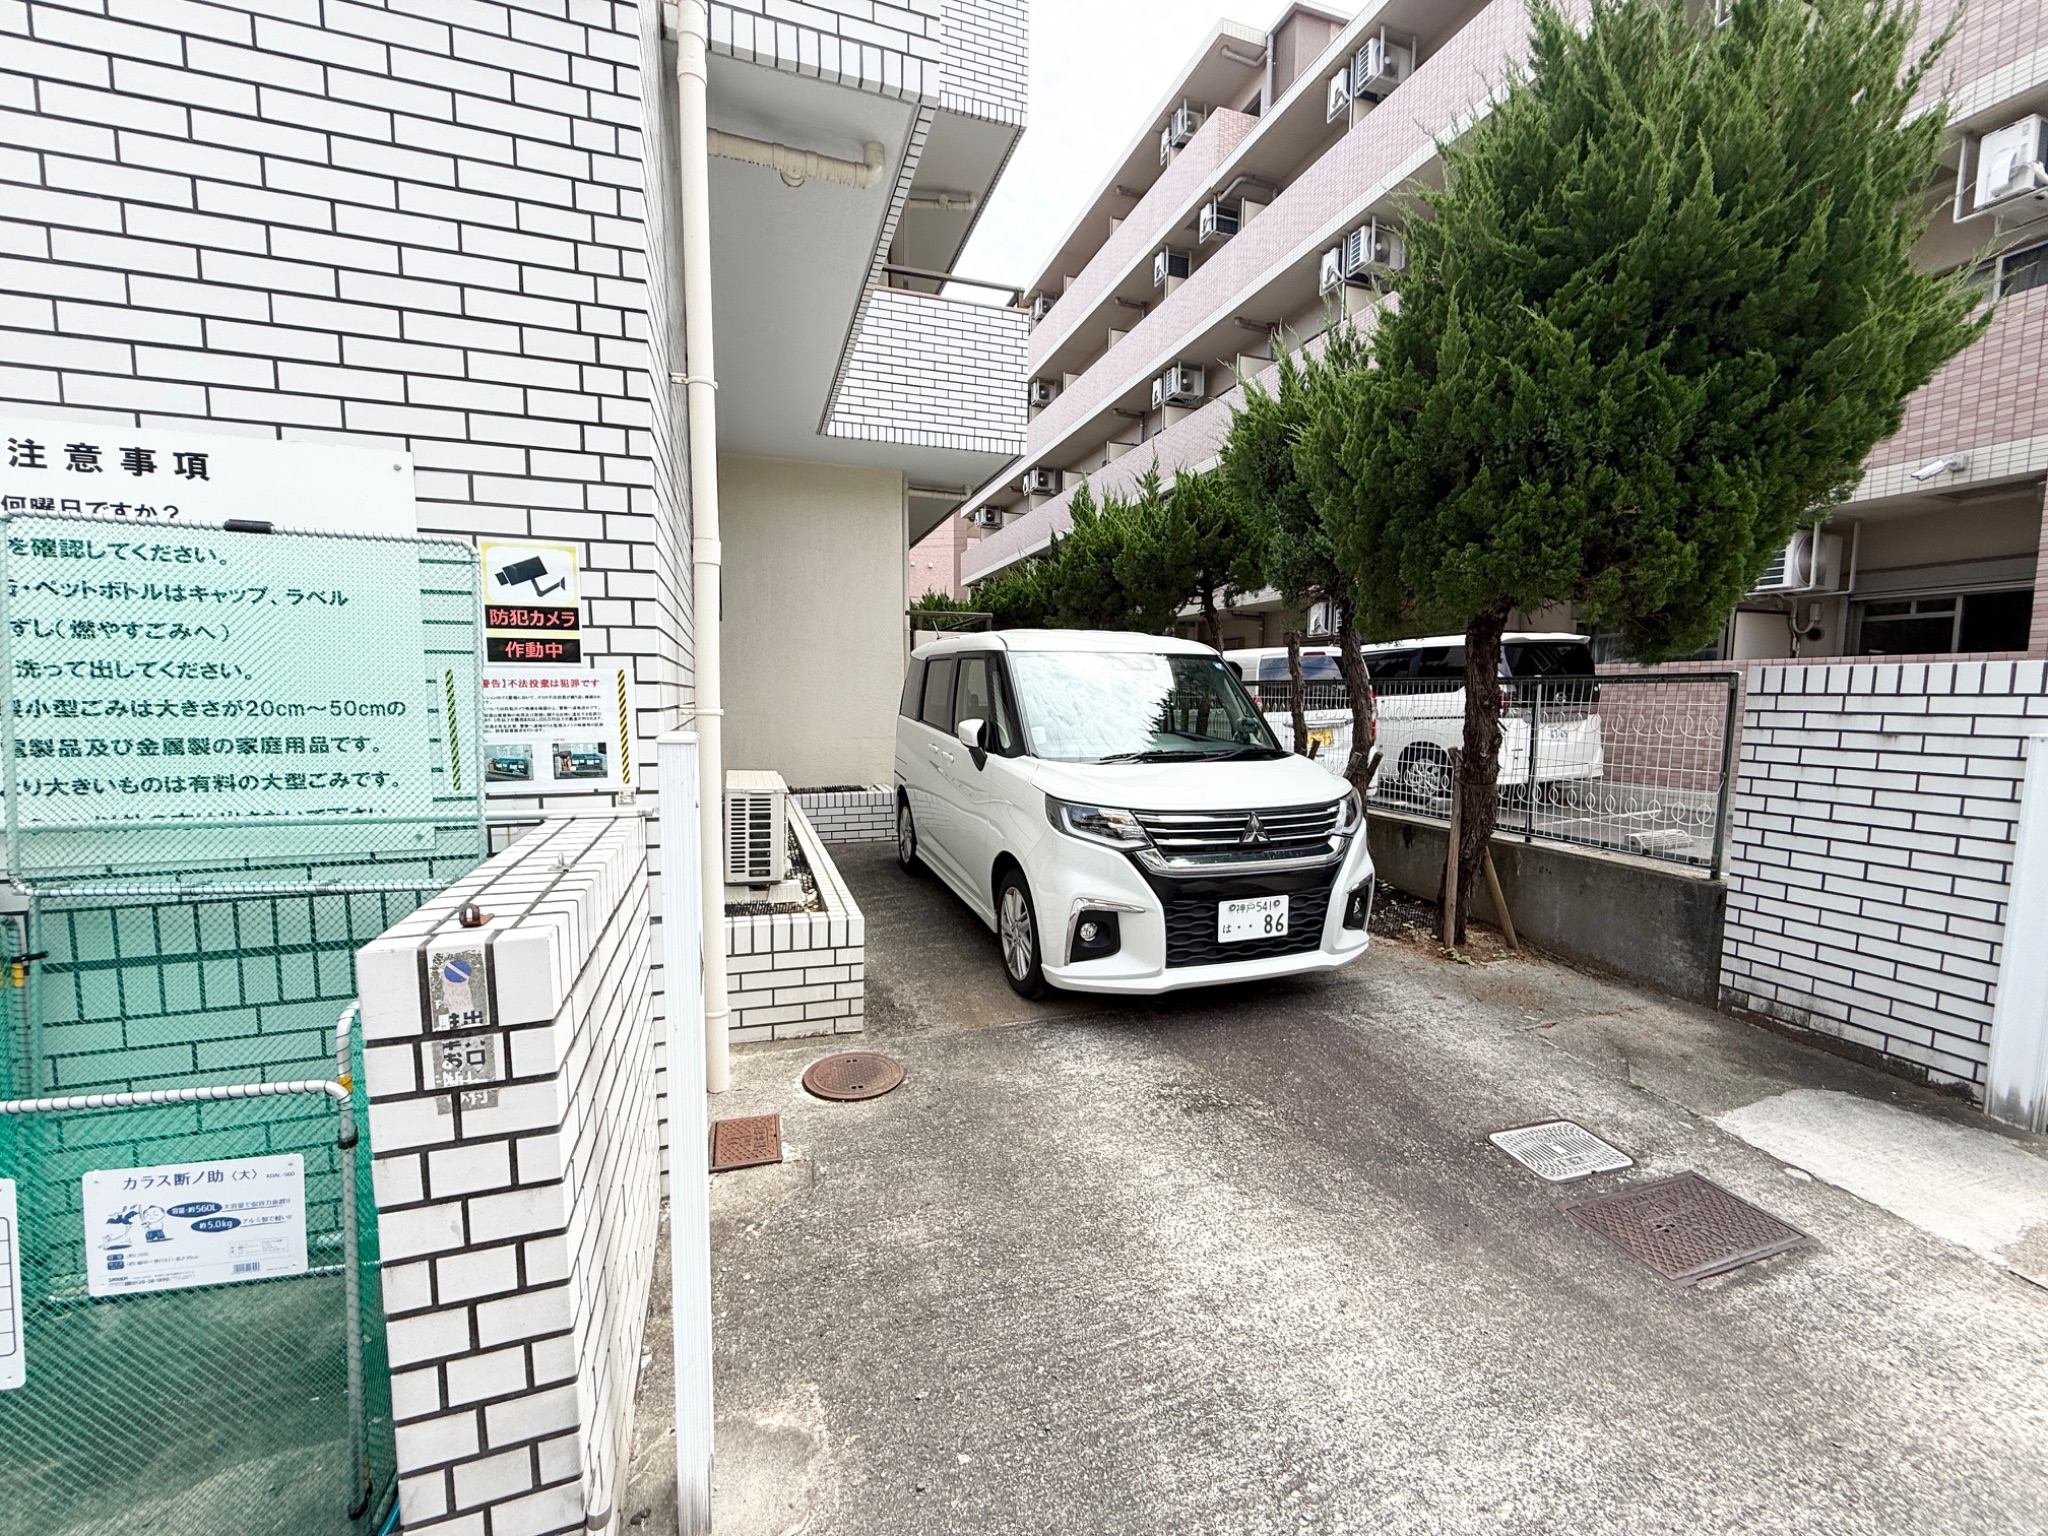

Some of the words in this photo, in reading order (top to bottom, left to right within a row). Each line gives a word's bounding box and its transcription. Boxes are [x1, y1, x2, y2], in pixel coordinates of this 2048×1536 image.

[7, 437, 210, 481] 注意事項
[489, 609, 576, 628] 防犯カメラ
[505, 641, 563, 659] 作動中
[16, 770, 399, 797] り大きいものは有料の大型ごみです。
